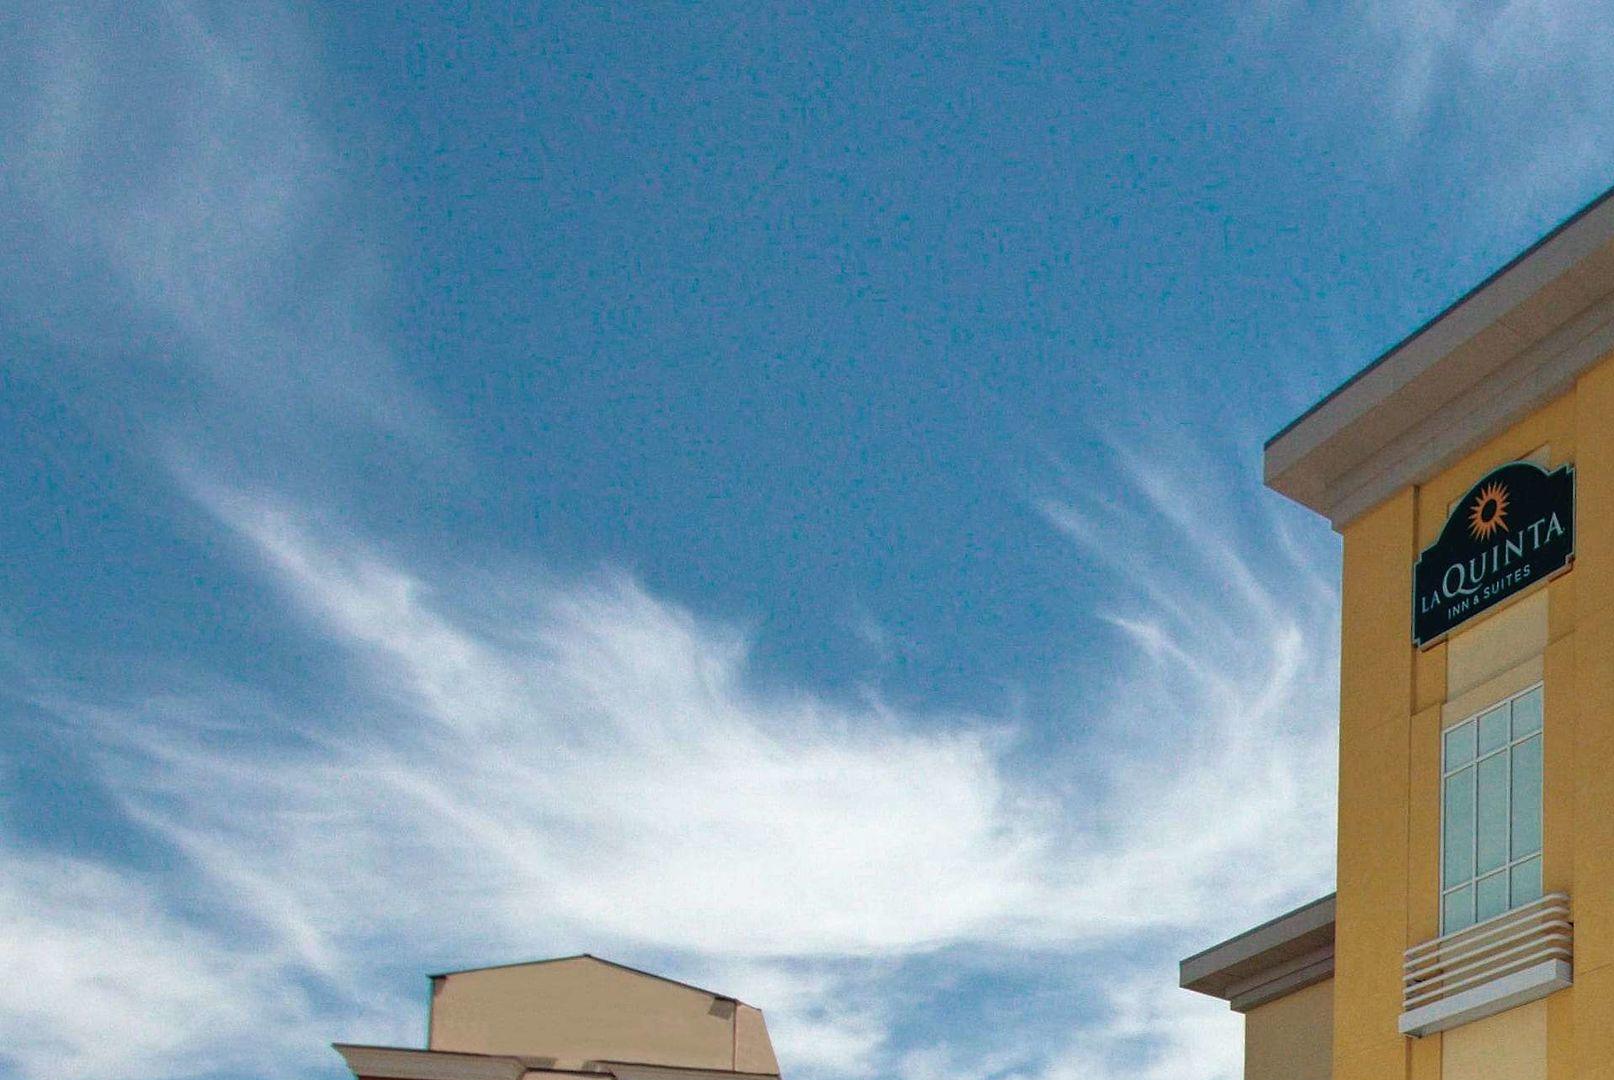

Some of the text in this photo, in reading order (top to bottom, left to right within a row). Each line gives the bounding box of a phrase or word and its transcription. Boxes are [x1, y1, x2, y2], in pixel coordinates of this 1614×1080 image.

[1421, 512, 1563, 614] LA QUINTA
[1448, 564, 1531, 620] INN & SUITES
